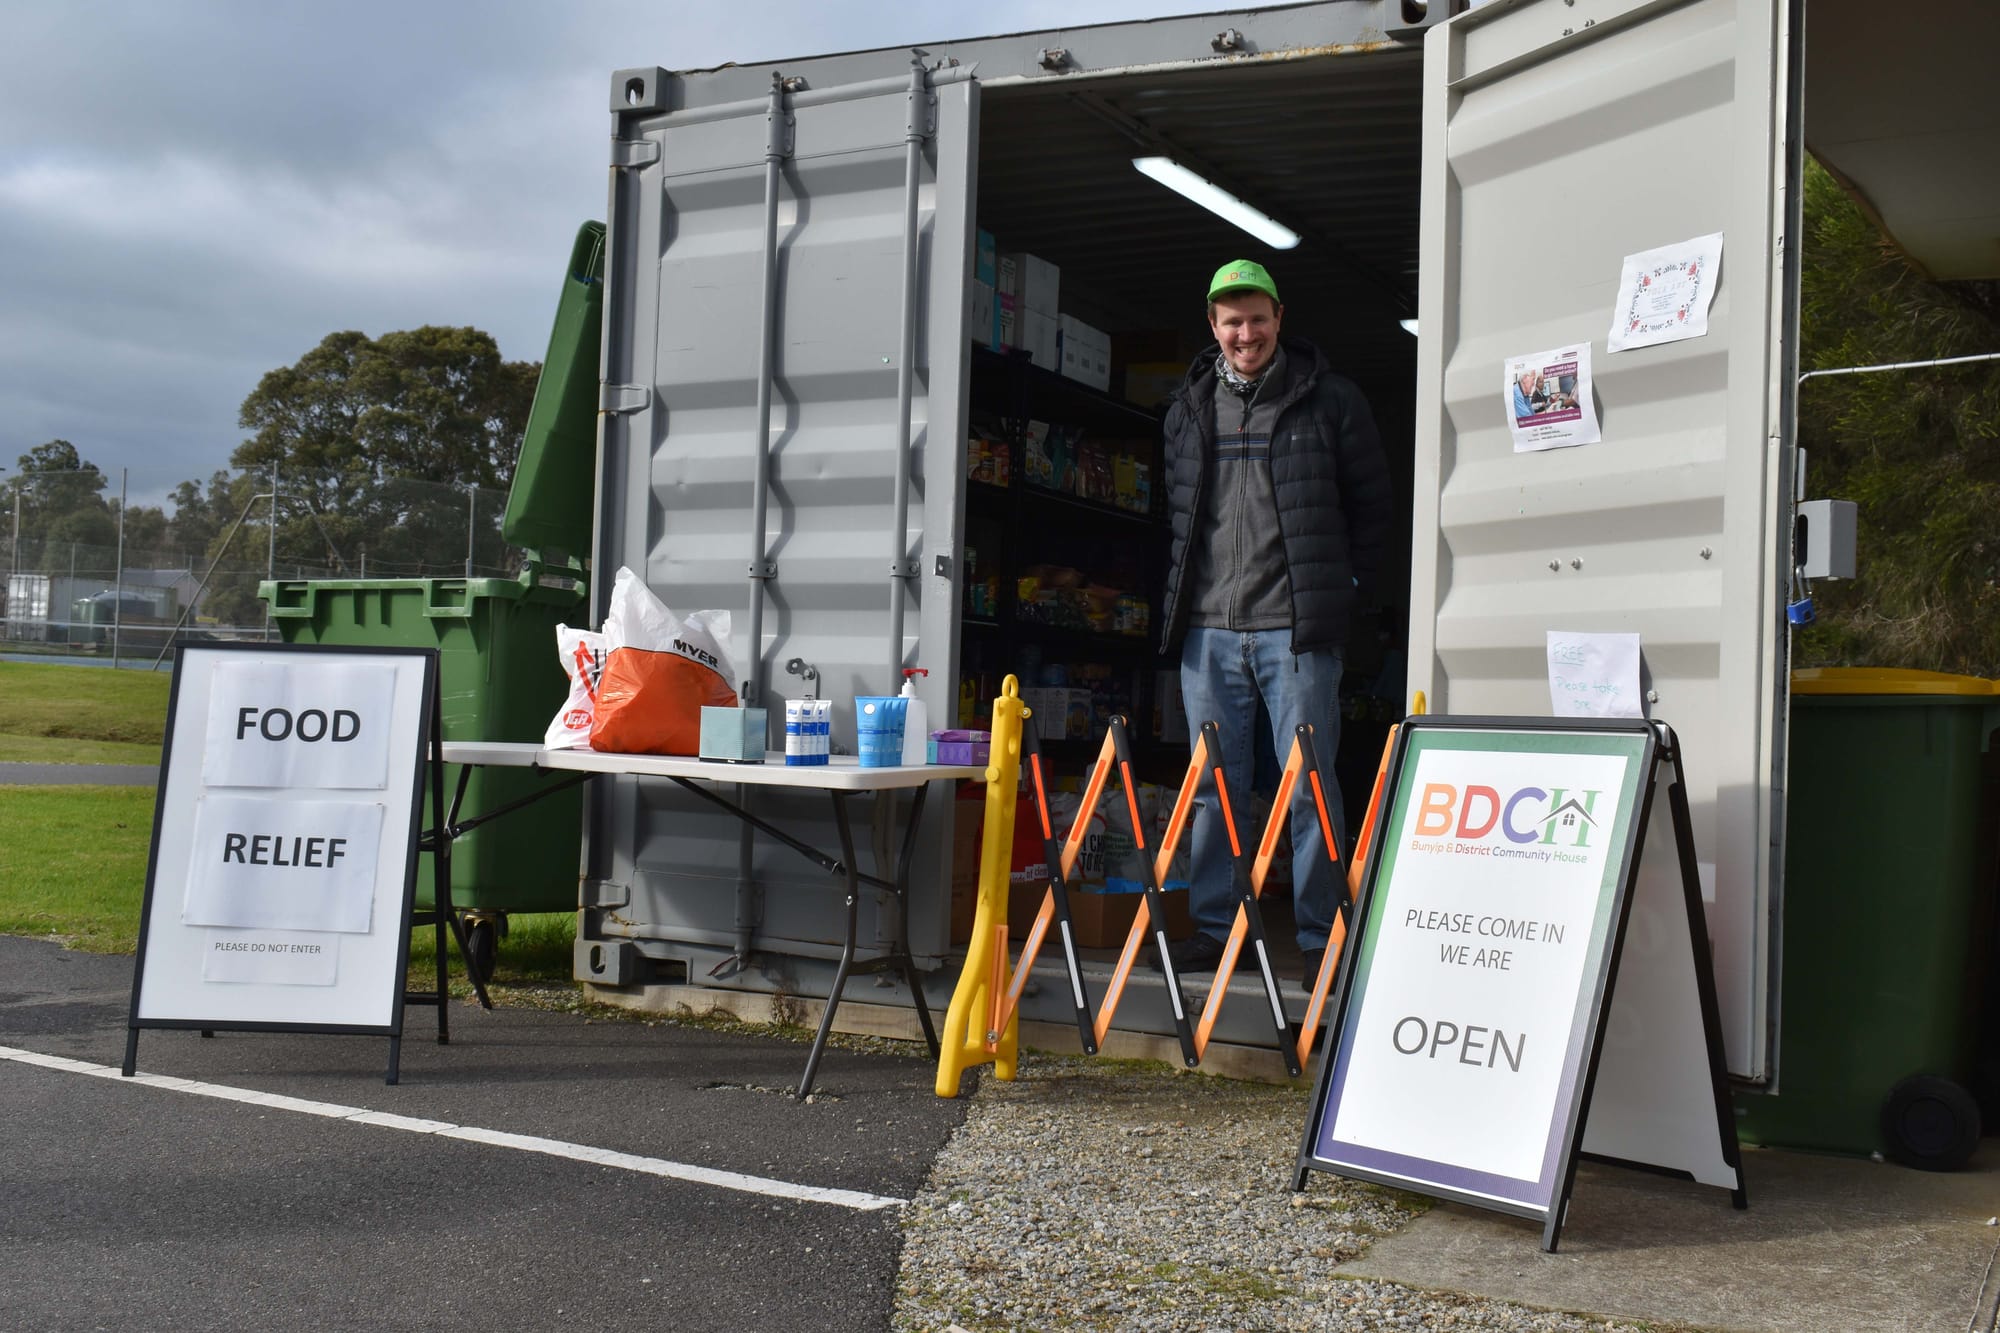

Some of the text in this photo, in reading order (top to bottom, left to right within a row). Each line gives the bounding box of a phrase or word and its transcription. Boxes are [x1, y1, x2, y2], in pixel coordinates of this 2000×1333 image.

[672, 639, 719, 668] MYER
[1551, 642, 1584, 663] FREE
[236, 707, 361, 743] FOOD
[565, 713, 589, 728] IGA
[1414, 783, 1603, 848] BDCH
[223, 833, 347, 868] RELIEF
[1411, 840, 1588, 864] Bunyip & District Community House
[1405, 909, 1566, 944] PLEASE COME IN
[214, 942, 321, 954] PLEASE DO NOT ENTER
[1440, 944, 1513, 970] WE ARE
[1393, 1016, 1526, 1073] OPEN
